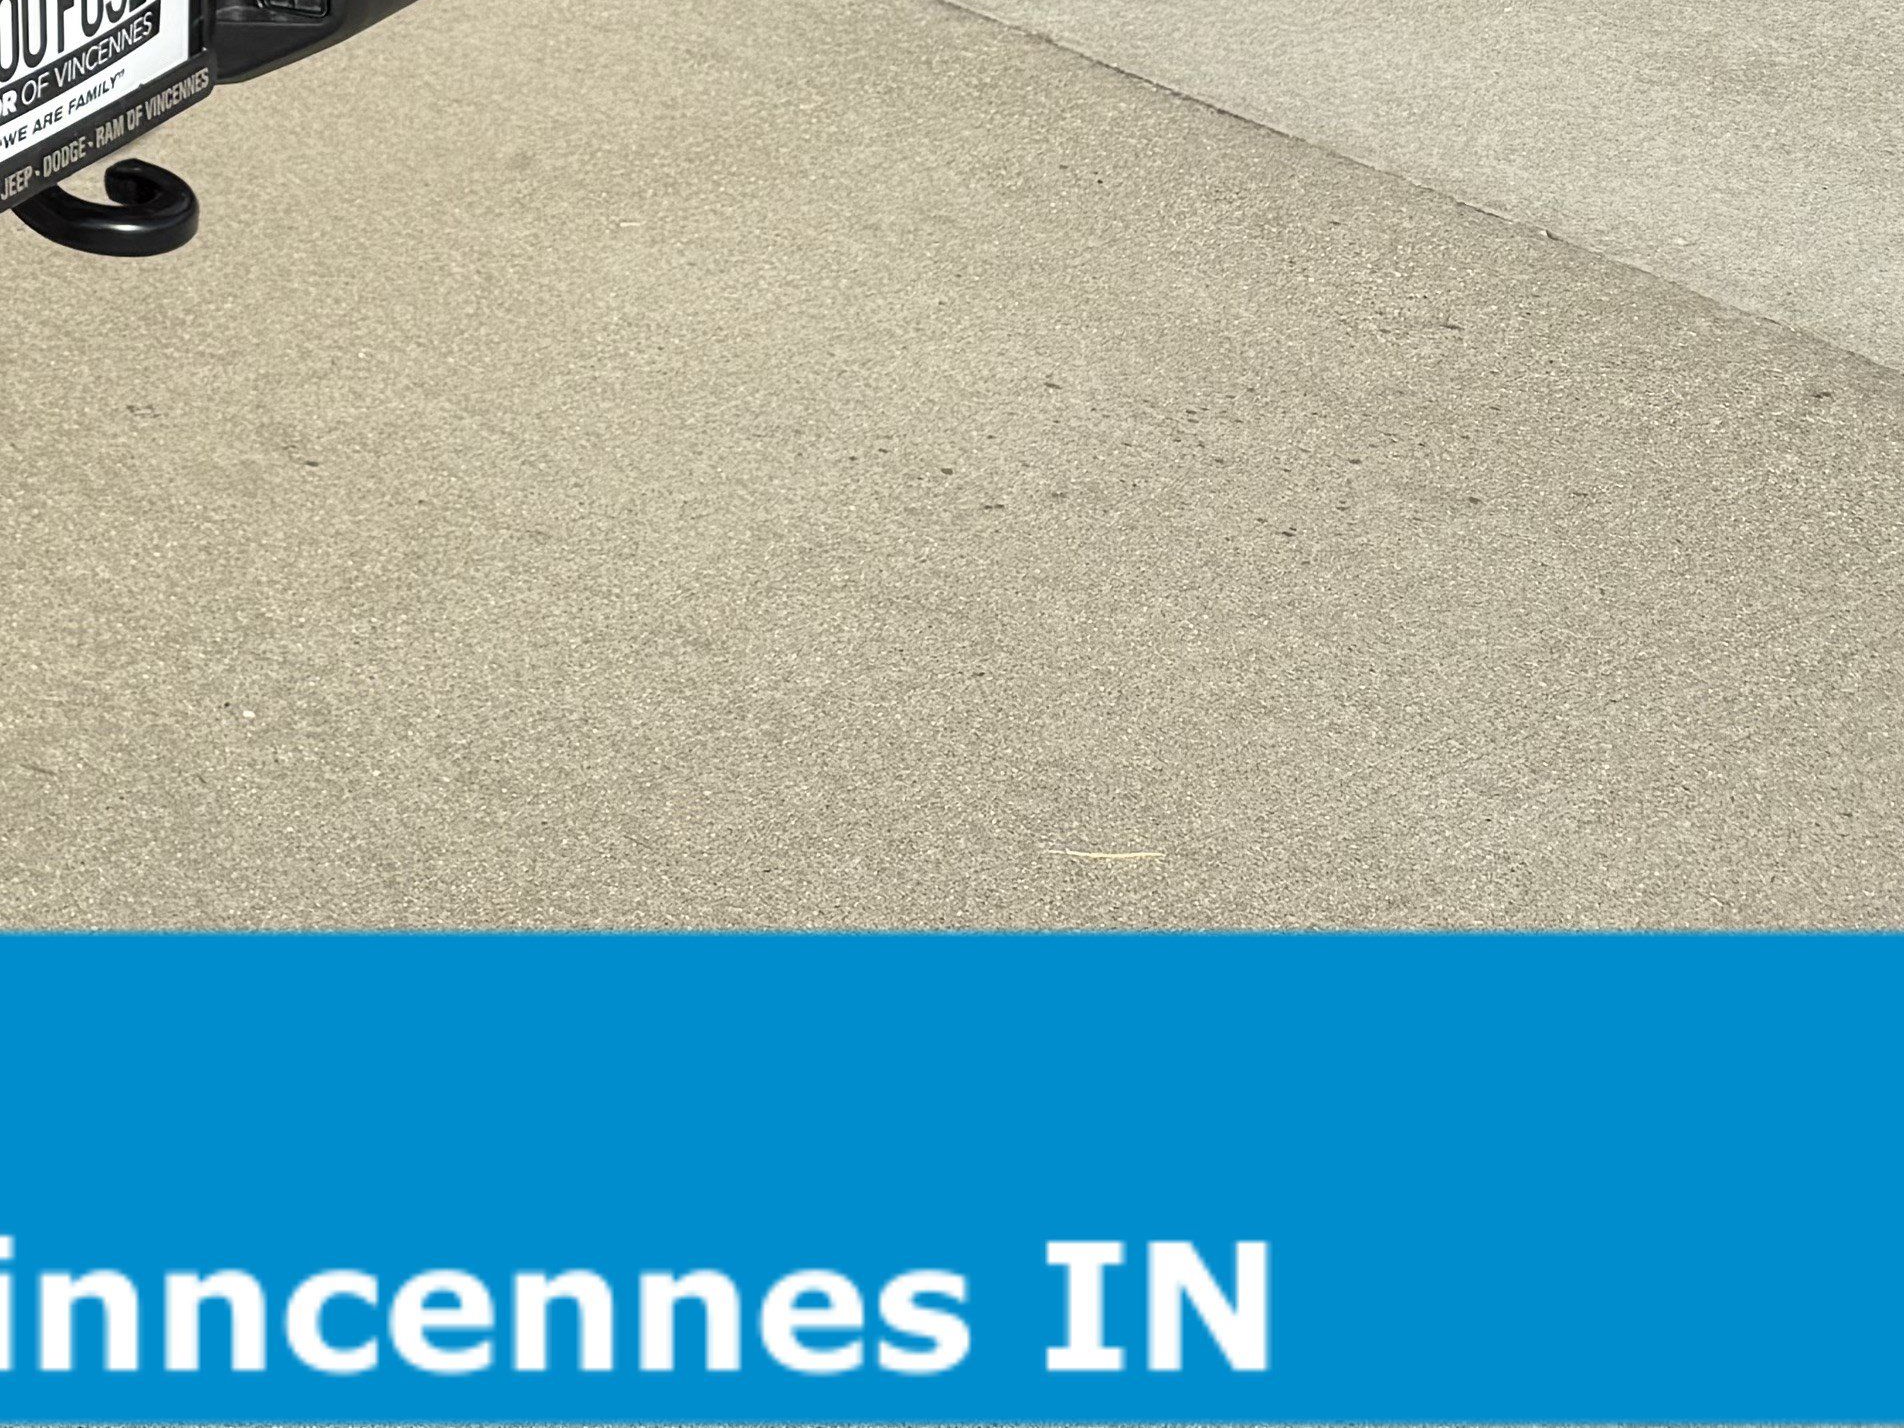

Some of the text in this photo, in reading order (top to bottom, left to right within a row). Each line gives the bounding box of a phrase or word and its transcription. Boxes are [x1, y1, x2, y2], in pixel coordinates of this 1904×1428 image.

[21, 73, 51, 107] OF
[54, 10, 154, 86] VINCENNES
[0, 166, 34, 202] JEEP
[42, 136, 89, 179] DODGE
[95, 115, 126, 150] RAM
[145, 67, 211, 122] VINCENNES
[31, 109, 64, 138] ARE
